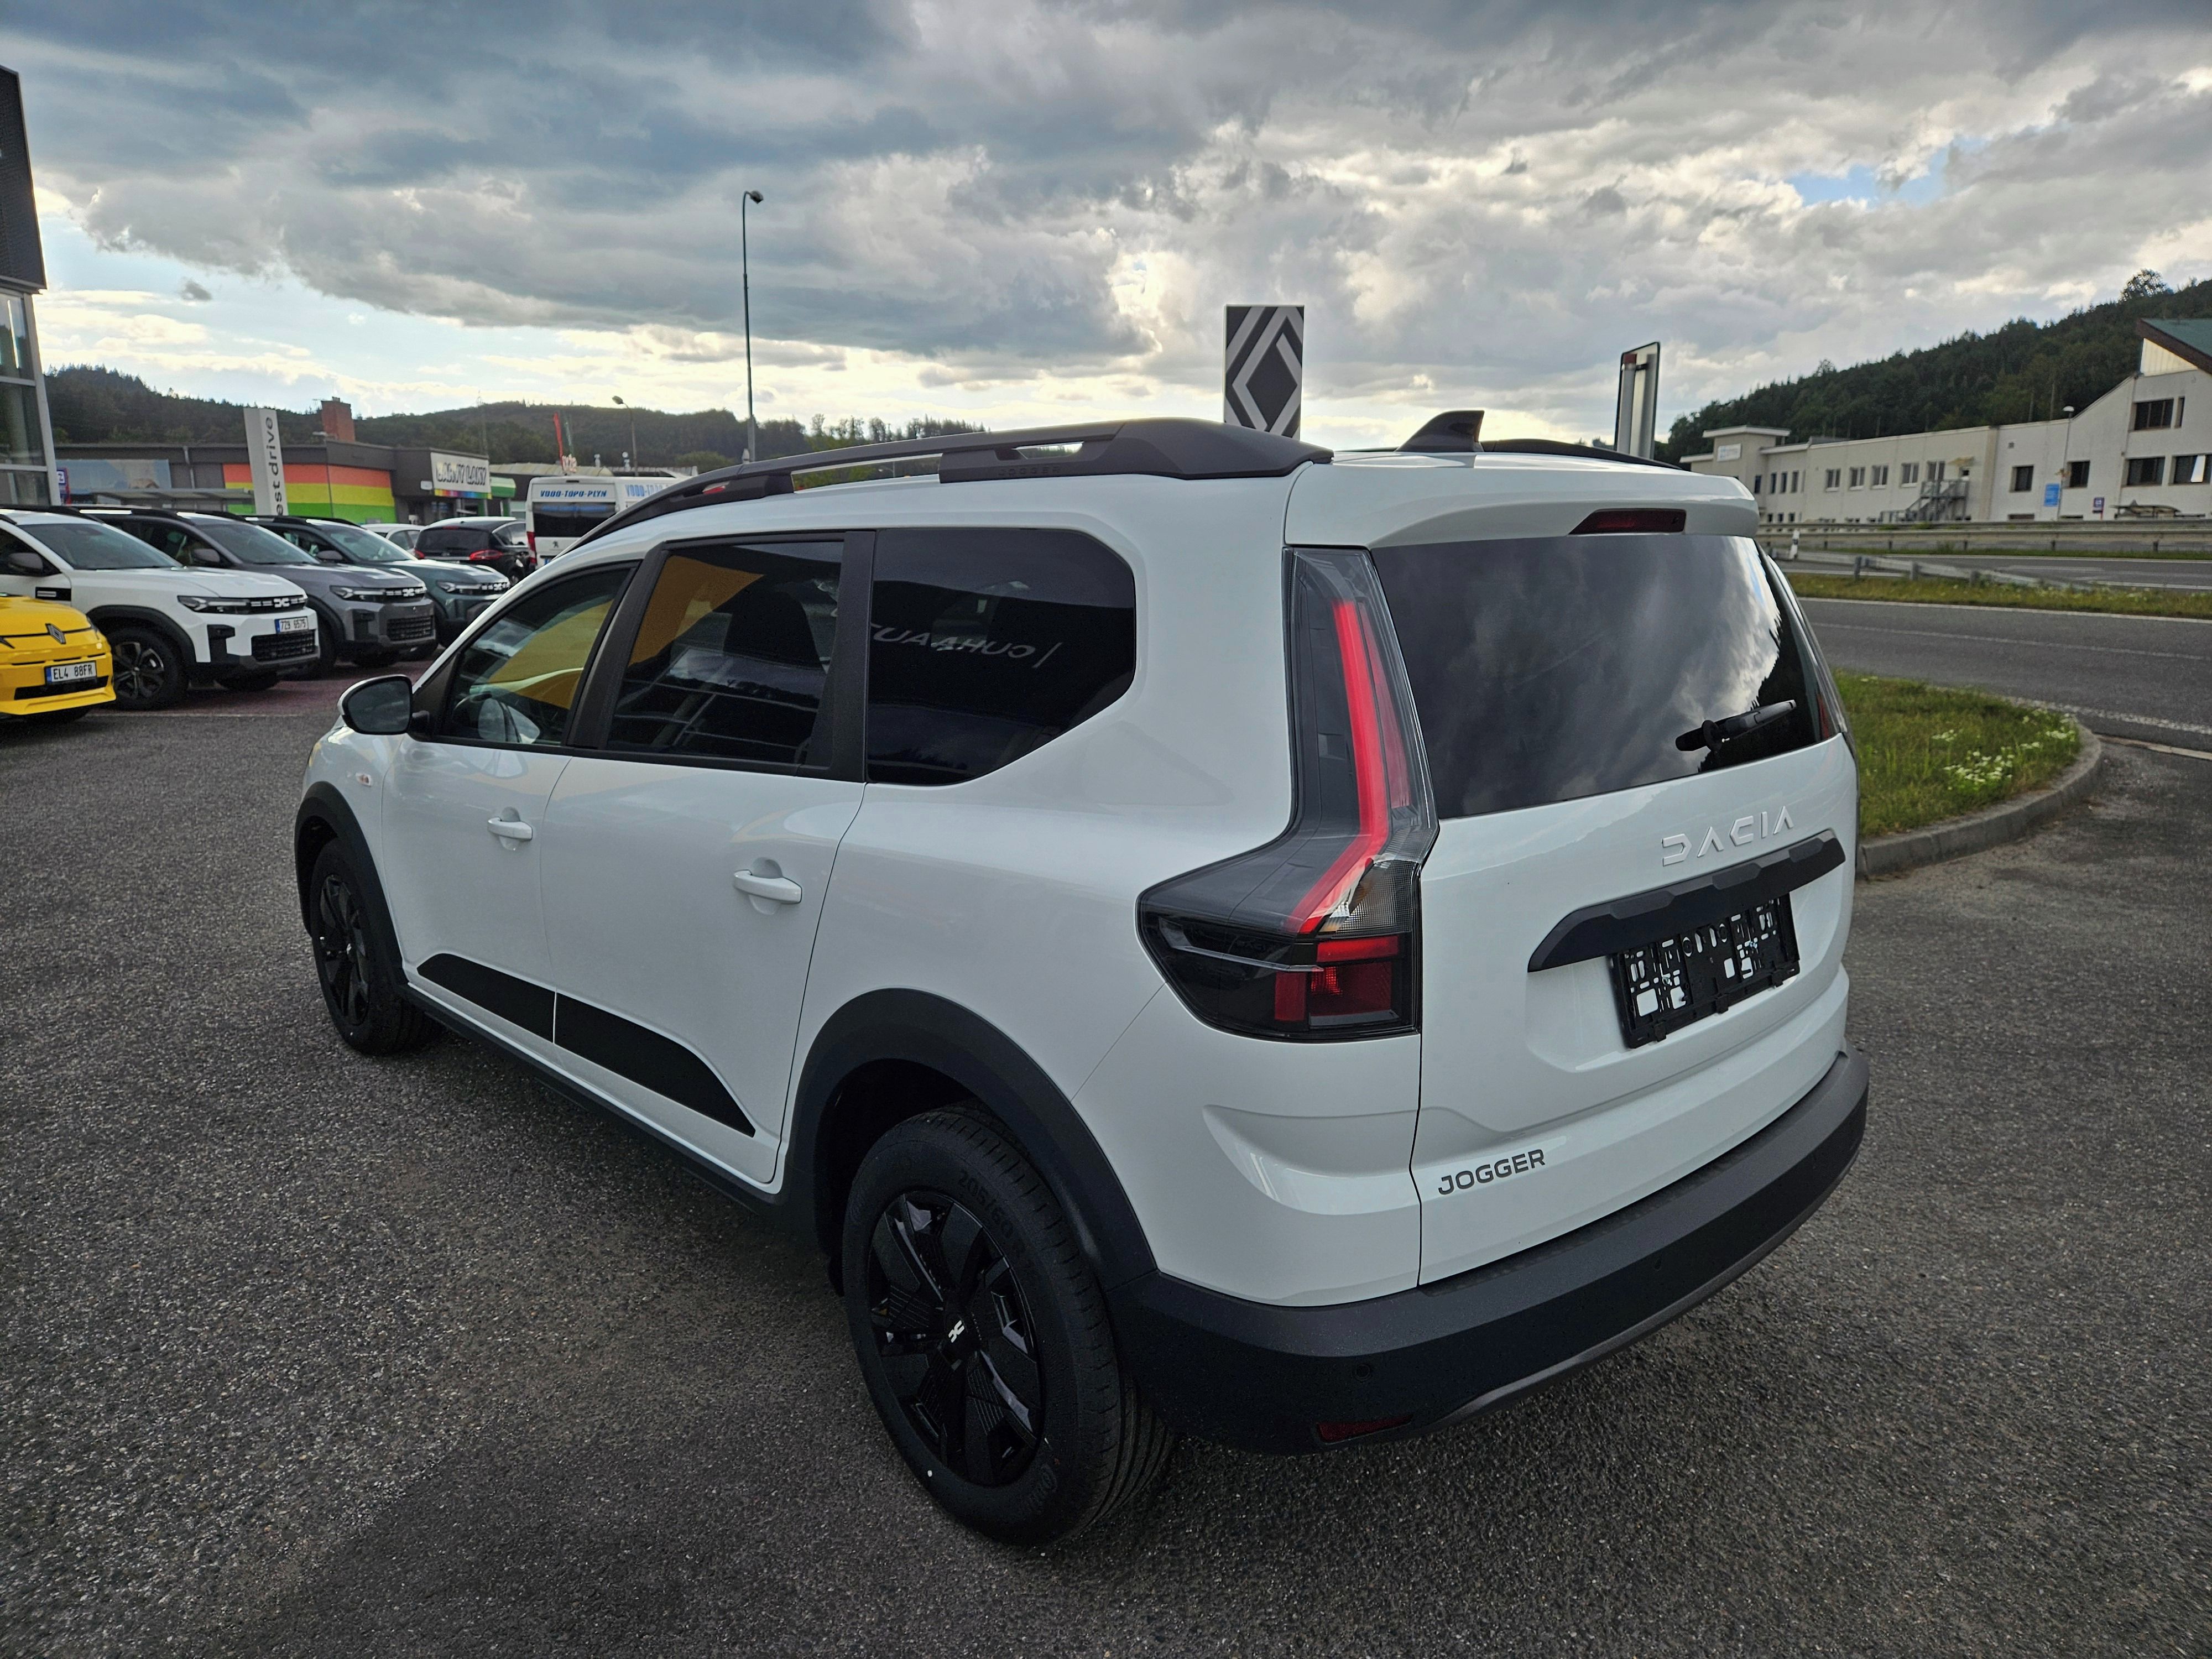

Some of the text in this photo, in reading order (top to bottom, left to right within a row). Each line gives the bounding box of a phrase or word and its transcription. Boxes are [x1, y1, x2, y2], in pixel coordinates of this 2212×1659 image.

[265, 417, 284, 516] est drive
[53, 664, 93, 680] EL4 88FR
[1662, 805, 1794, 867] DACIA
[1438, 1149, 1546, 1195] JOGGER
